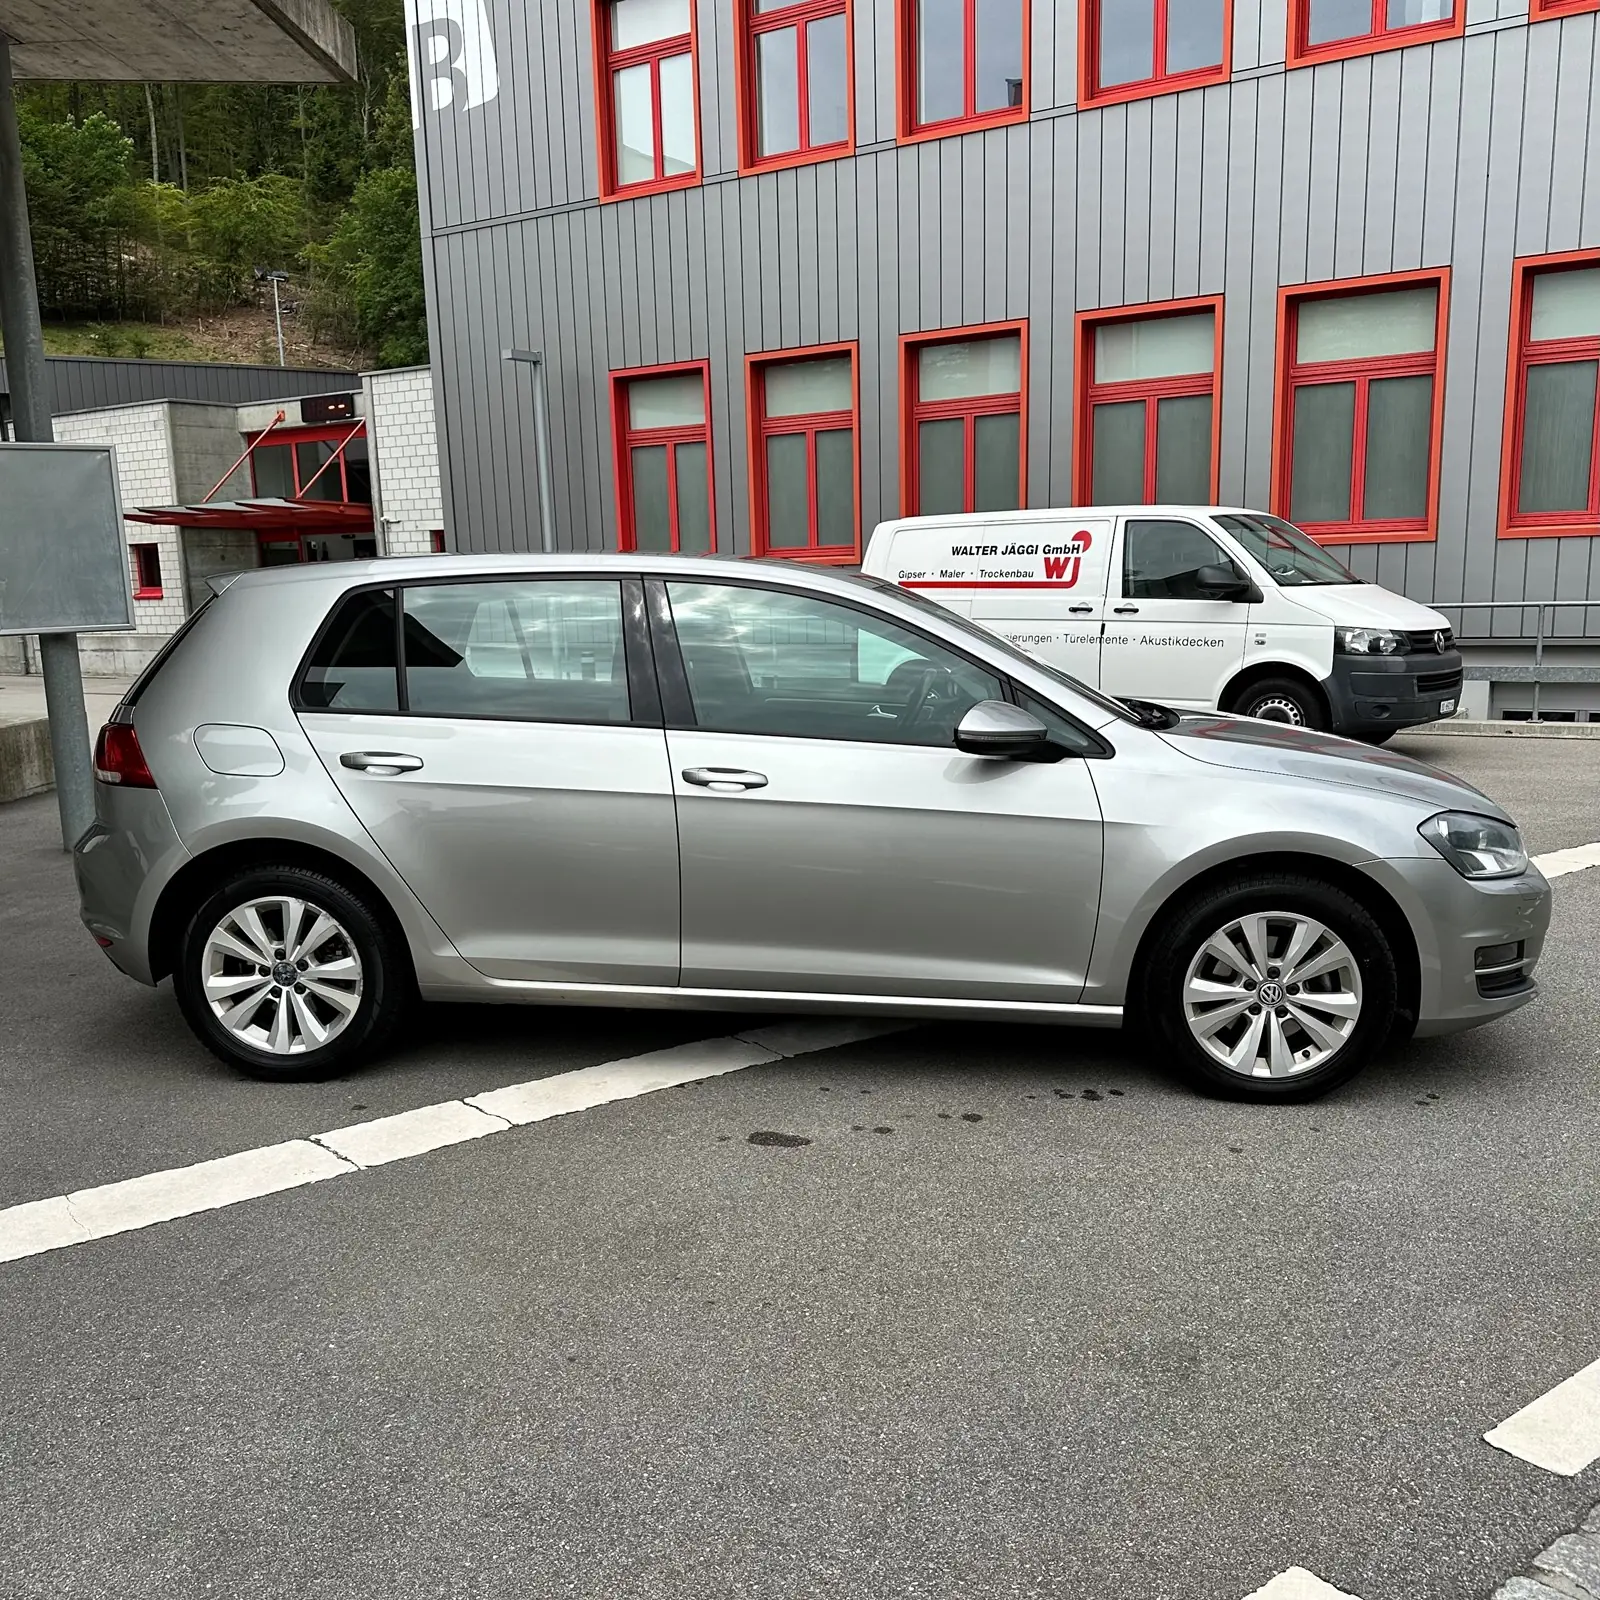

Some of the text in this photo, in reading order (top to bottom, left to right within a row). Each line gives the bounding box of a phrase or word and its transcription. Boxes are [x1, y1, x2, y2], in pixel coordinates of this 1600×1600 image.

[412, 17, 467, 128] B
[951, 542, 1081, 556] WALTER JÄGGI GmbH
[898, 568, 1035, 580] Gipser Maler Trockenbau
[1063, 633, 1129, 645] Türelemente
[1140, 635, 1225, 648] Akustikdecken
